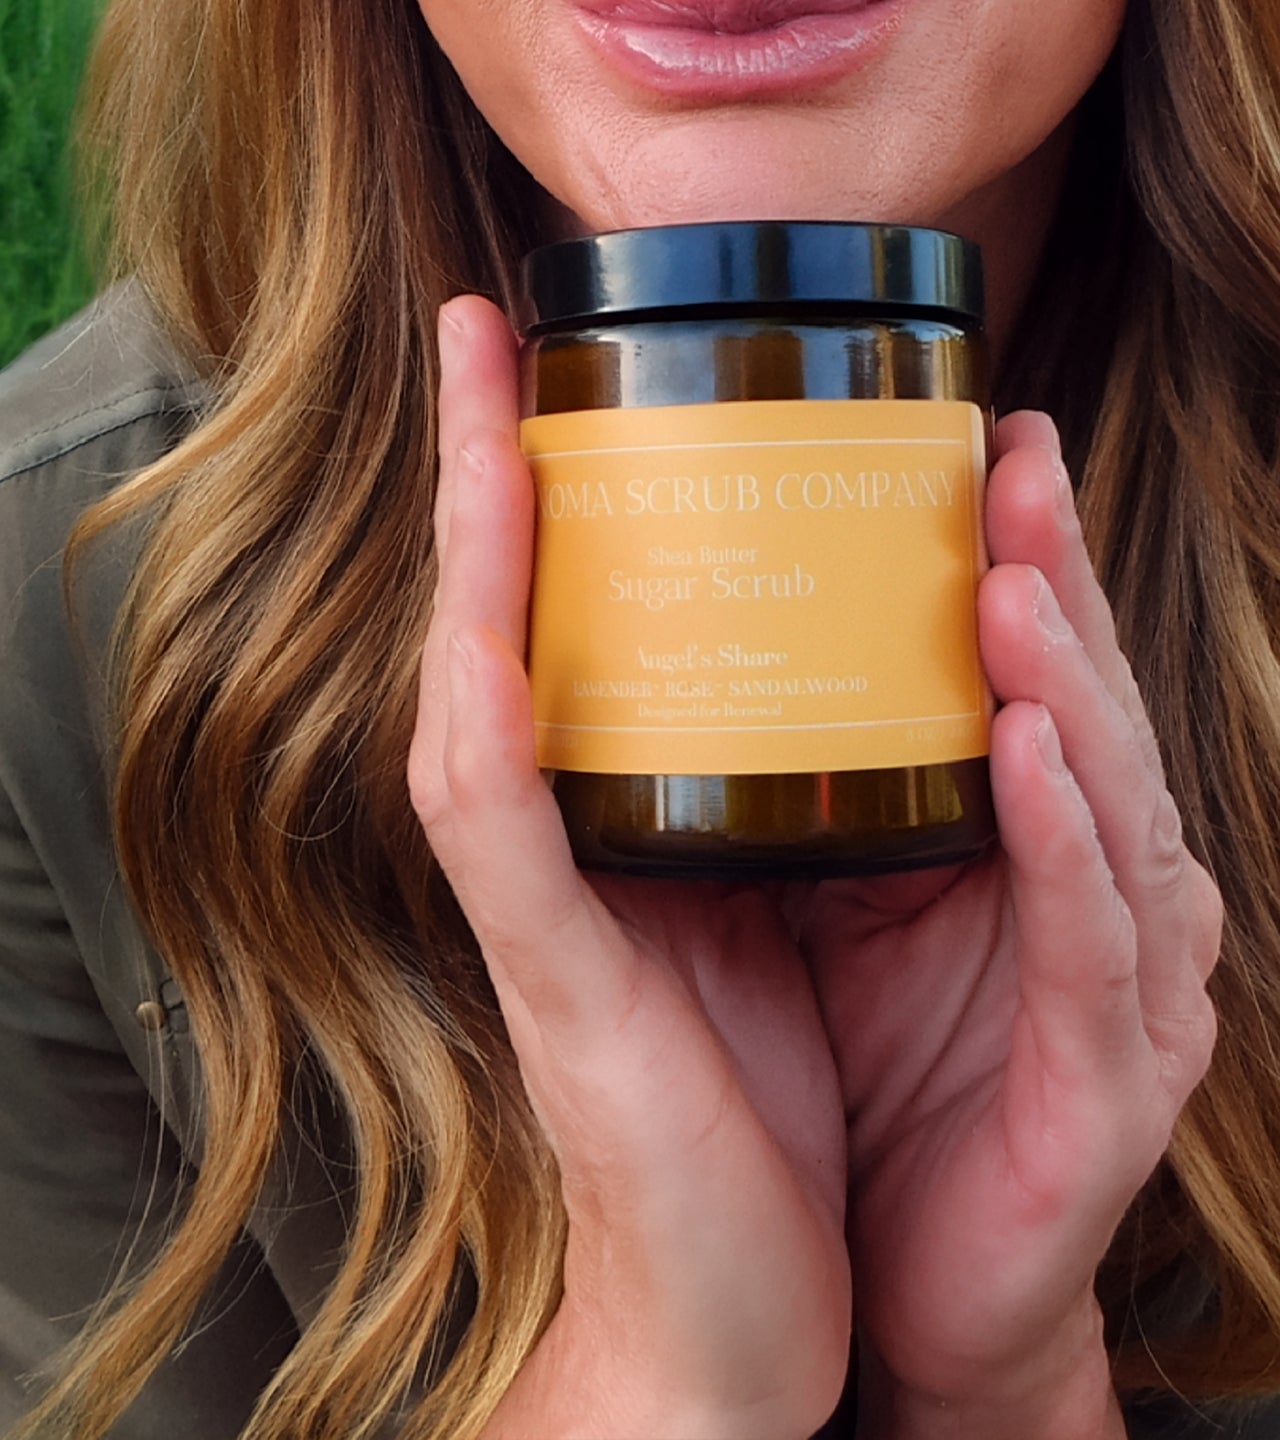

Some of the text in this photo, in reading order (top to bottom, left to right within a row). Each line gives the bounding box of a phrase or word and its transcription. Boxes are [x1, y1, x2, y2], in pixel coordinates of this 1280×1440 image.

[625, 474, 761, 515] SCRUB
[776, 469, 957, 511] COMPANY
[647, 544, 758, 566] Shea Butter
[608, 562, 816, 611] Sugar Scrub
[718, 643, 789, 667] Share
[728, 675, 869, 697] SANDALWOOD
